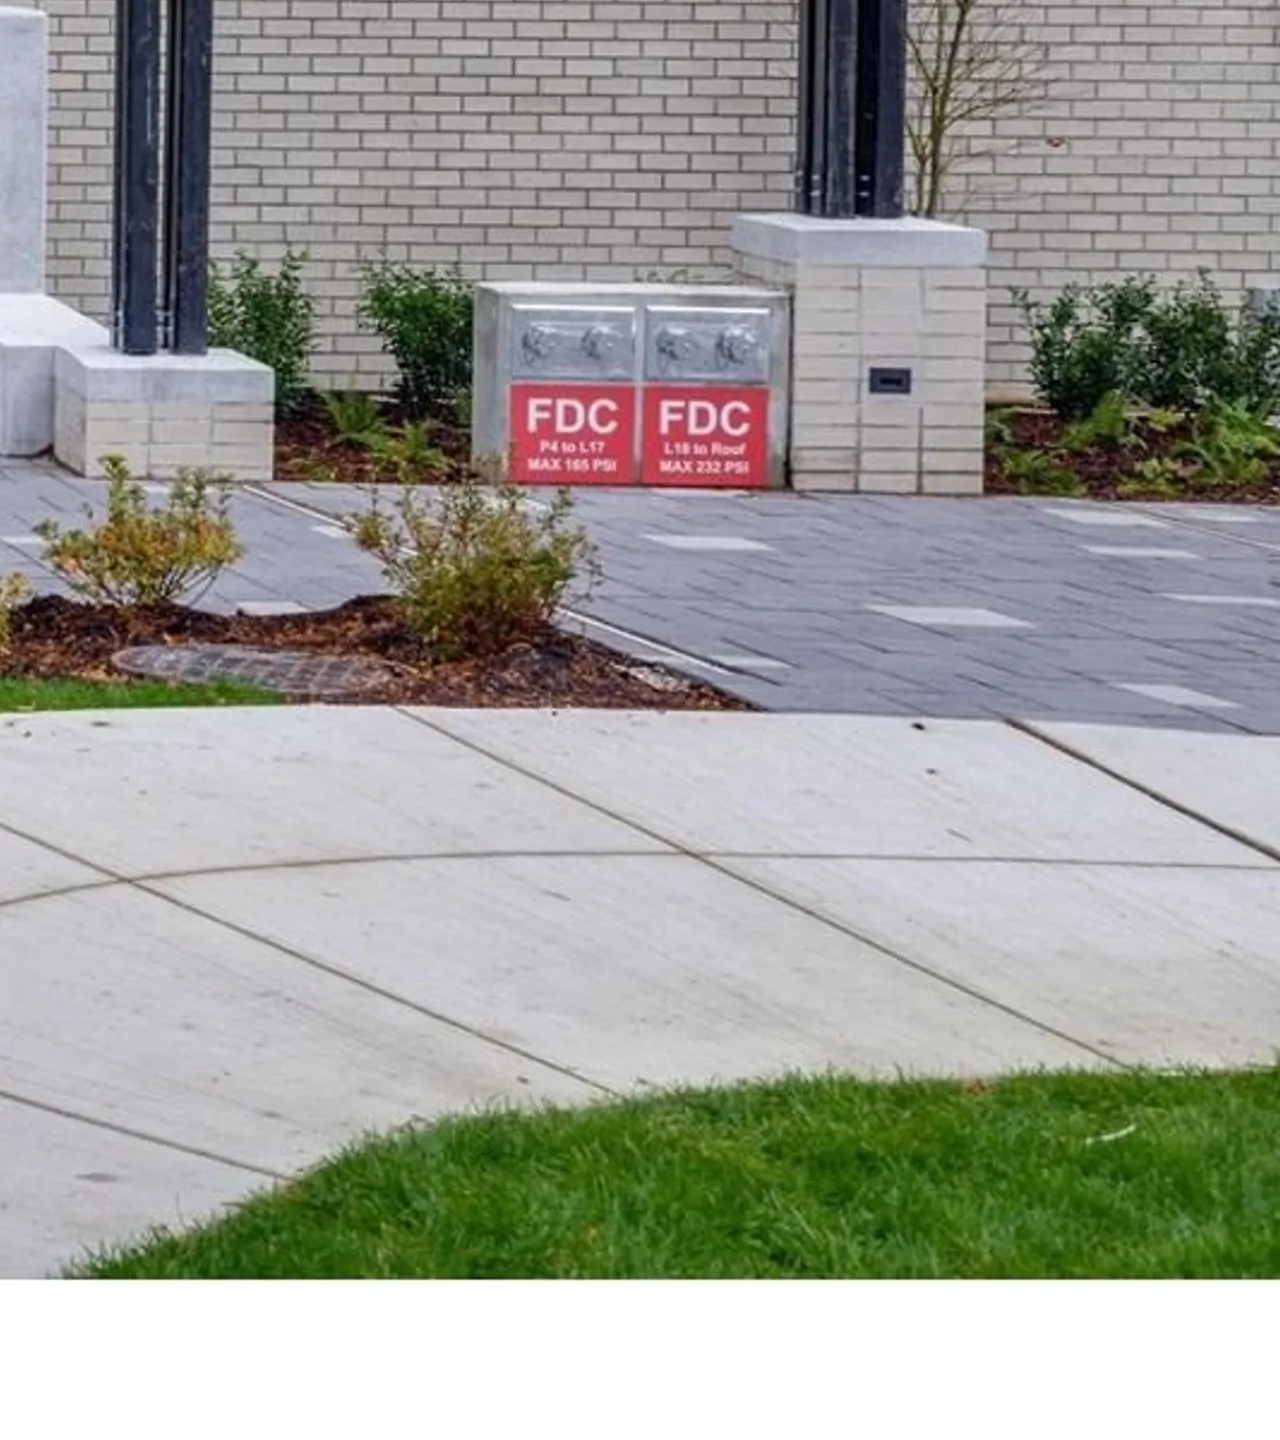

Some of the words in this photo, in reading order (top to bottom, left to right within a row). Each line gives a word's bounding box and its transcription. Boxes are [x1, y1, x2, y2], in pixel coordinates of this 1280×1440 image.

[527, 398, 619, 435] FDC
[659, 400, 751, 436] FDC
[540, 441, 559, 453] P4
[562, 441, 577, 453] to
[579, 441, 605, 453] L17
[693, 443, 708, 455] to
[711, 442, 746, 455] Roof
[528, 458, 561, 471] MAX
[592, 459, 617, 472] PSI
[659, 461, 693, 473] MAX
[696, 461, 721, 474] 232
[724, 461, 750, 474] PSI
